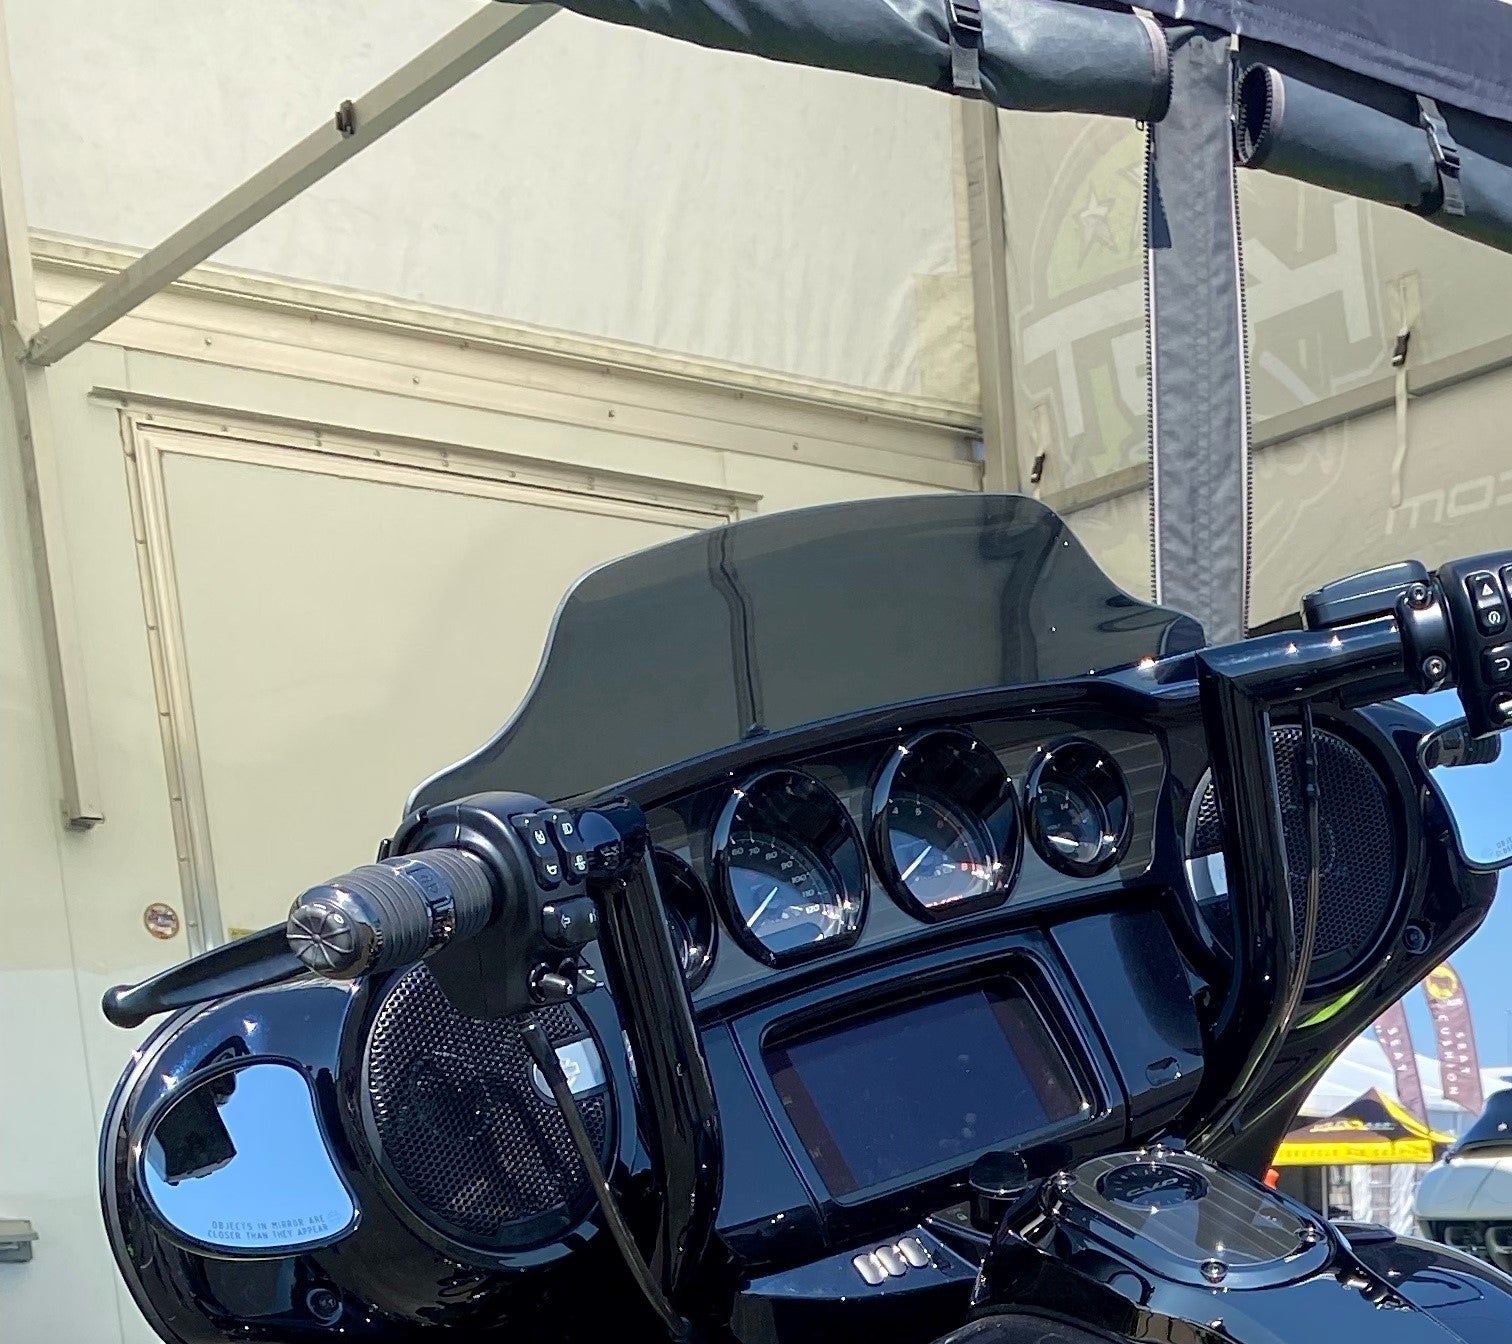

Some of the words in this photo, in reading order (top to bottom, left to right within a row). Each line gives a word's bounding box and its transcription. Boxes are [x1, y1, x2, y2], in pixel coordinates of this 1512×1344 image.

[1437, 1014, 1460, 1095] CUSHION
[212, 1219, 253, 1231] OBJECTS
[257, 1222, 267, 1230] IN
[271, 1218, 304, 1229] MIRROR
[309, 1214, 325, 1224] ARE
[207, 1229, 241, 1240] CLOSER
[246, 1231, 269, 1240] THAN
[271, 1229, 293, 1239] THEY
[297, 1223, 328, 1236] APPEAR
